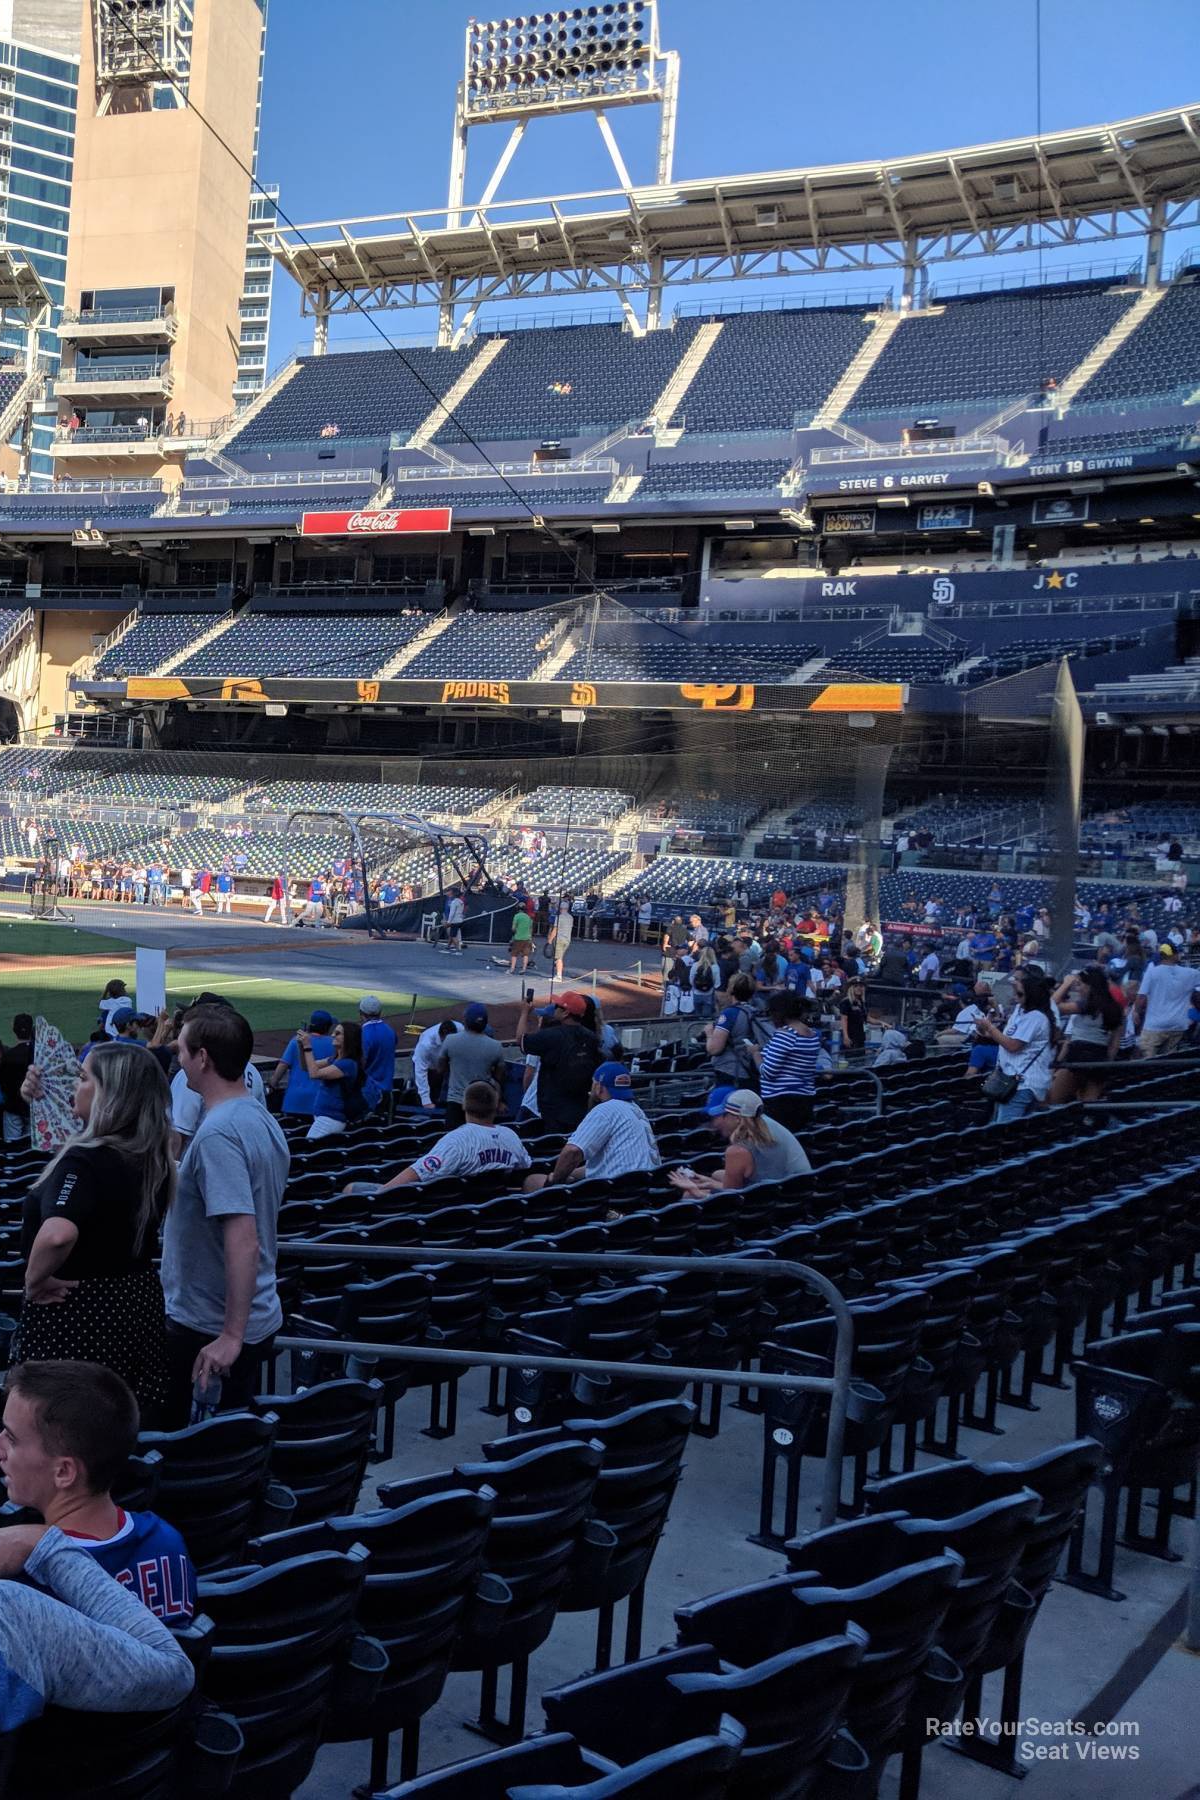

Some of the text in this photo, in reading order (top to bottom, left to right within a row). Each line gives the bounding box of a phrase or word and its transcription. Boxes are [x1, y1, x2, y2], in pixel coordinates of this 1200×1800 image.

[1029, 456, 1133, 476] TONY 19 GWYNN
[839, 473, 949, 490] STEVE 6 GARVEY
[347, 511, 402, 532] Coca-Cola
[822, 581, 856, 597] RAK
[1033, 572, 1078, 590] J C
[441, 681, 510, 704] PADRES
[479, 1148, 513, 1166] BRYANT
[1095, 1402, 1121, 1415] petco
